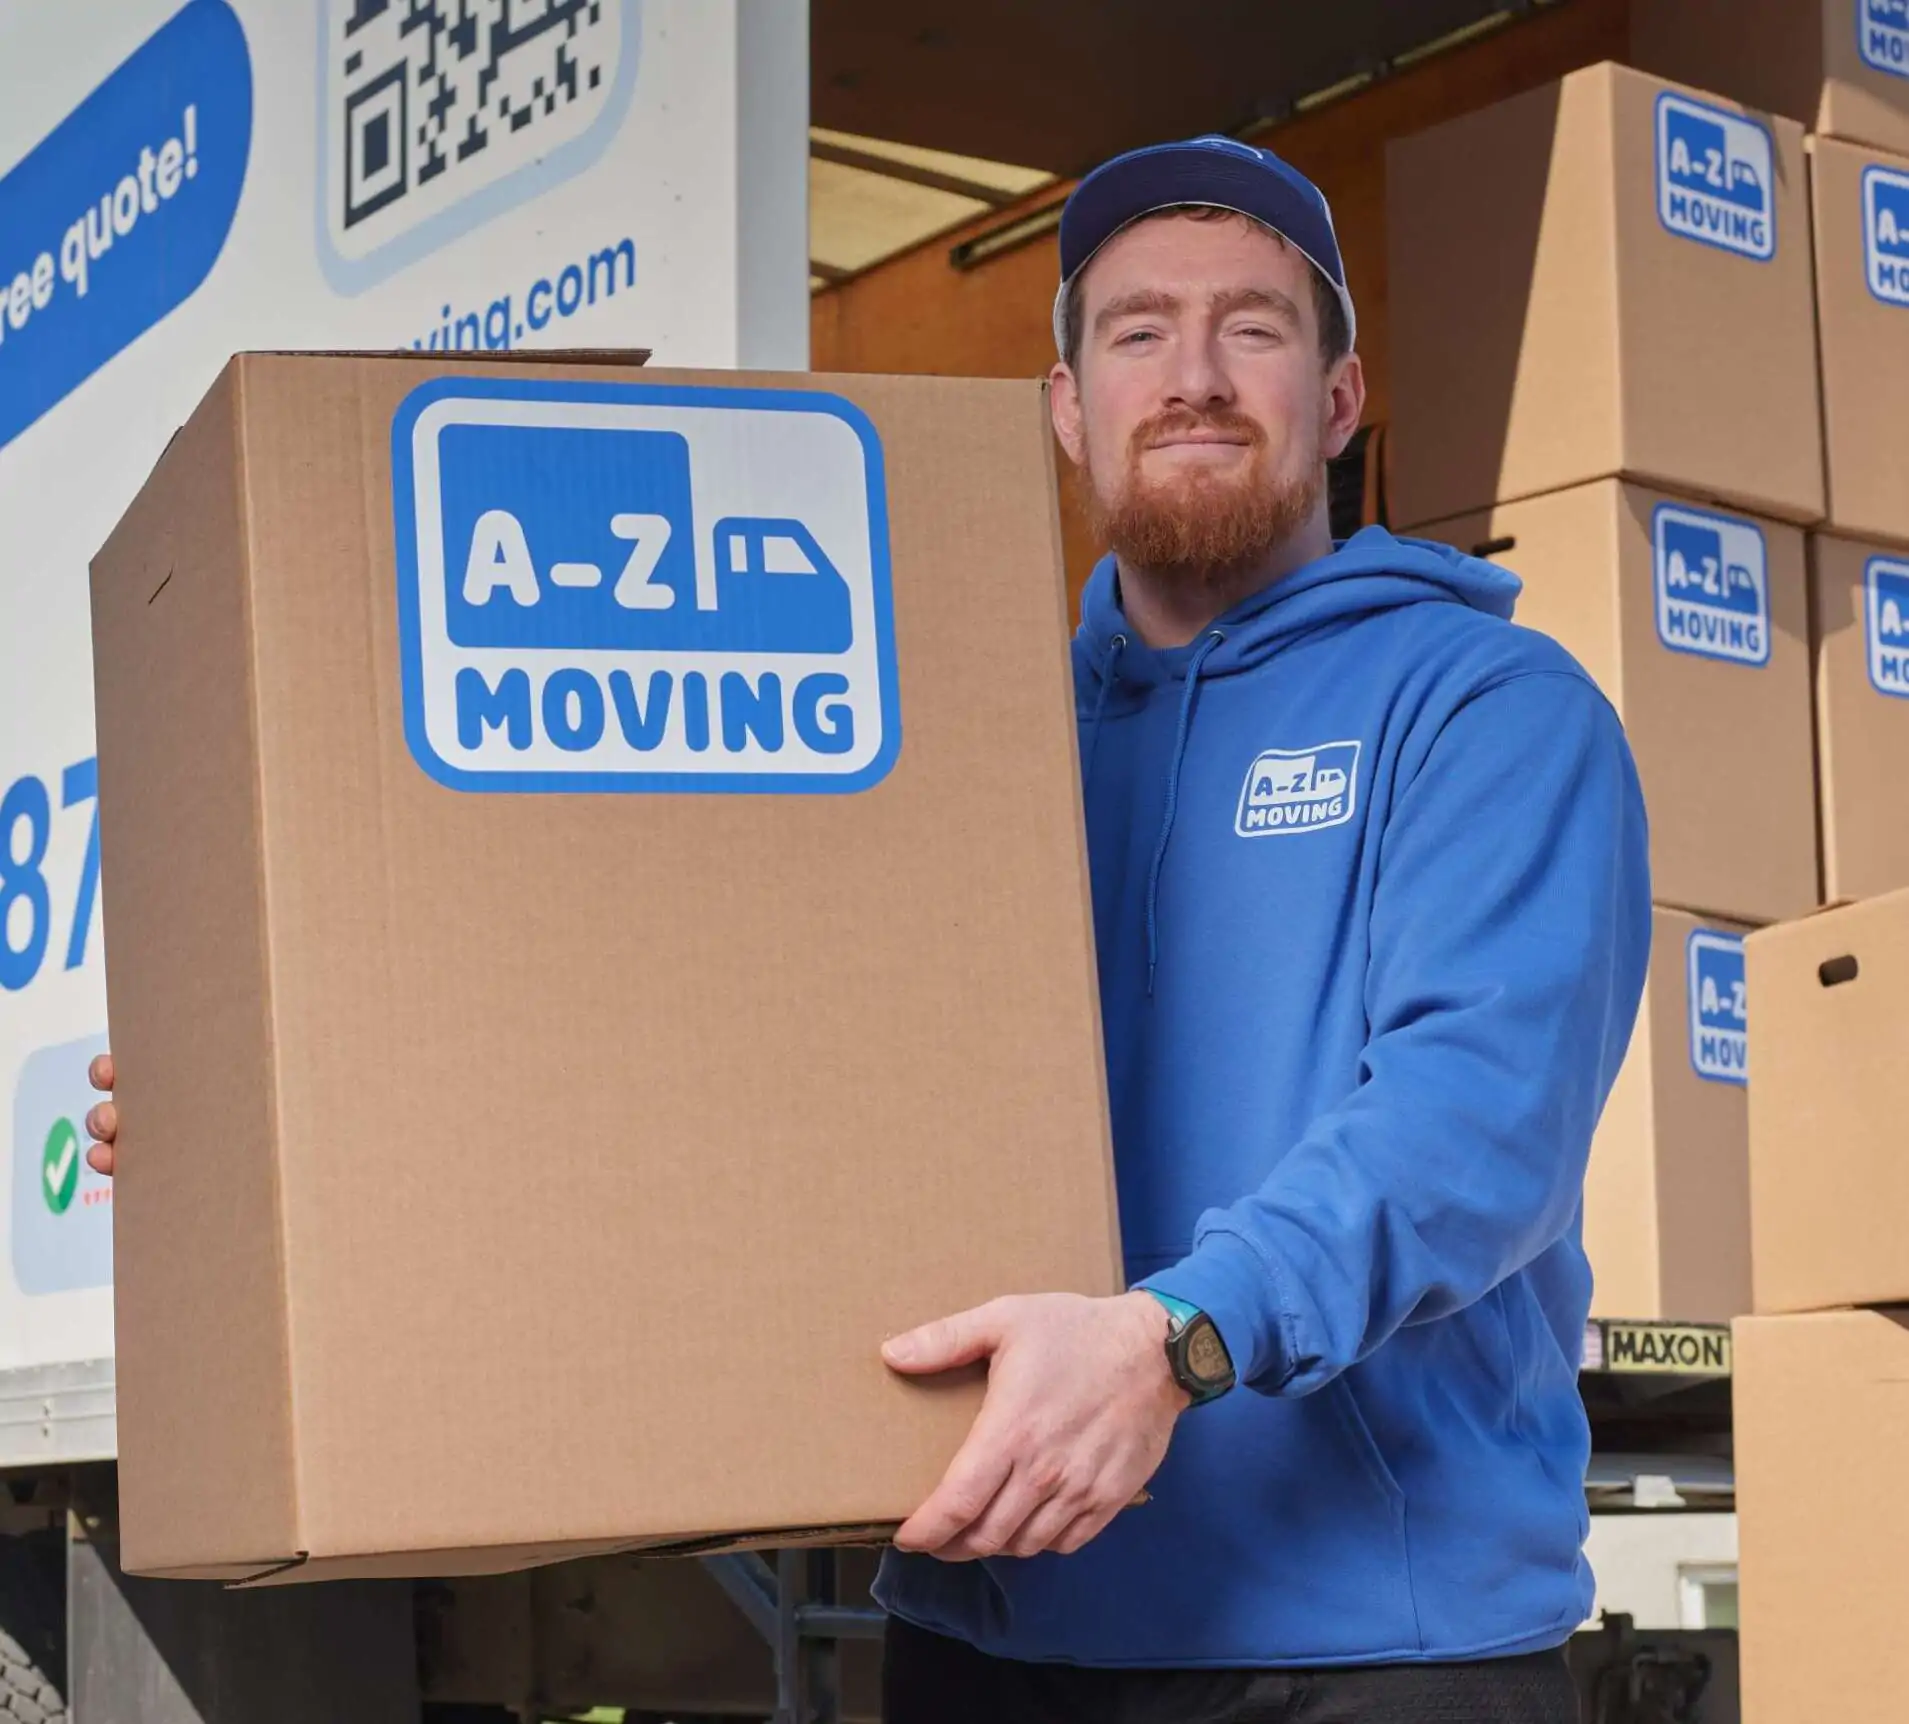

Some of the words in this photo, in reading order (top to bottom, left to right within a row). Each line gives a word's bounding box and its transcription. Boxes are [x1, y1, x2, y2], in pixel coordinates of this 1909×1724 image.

[1670, 137, 1723, 187] A-Z
[61, 104, 198, 298] quote!
[1669, 192, 1764, 247] MOVING
[462, 509, 676, 610] A-Z
[1668, 549, 1720, 595] A-Z
[1668, 607, 1760, 652] MOVING
[455, 667, 855, 755] MOVING
[1254, 772, 1307, 796] A-Z
[1246, 797, 1342, 828] MOVING
[0, 757, 101, 992] 87
[1701, 976, 1746, 1020] A-Z
[1613, 1331, 1723, 1366] MAXON
